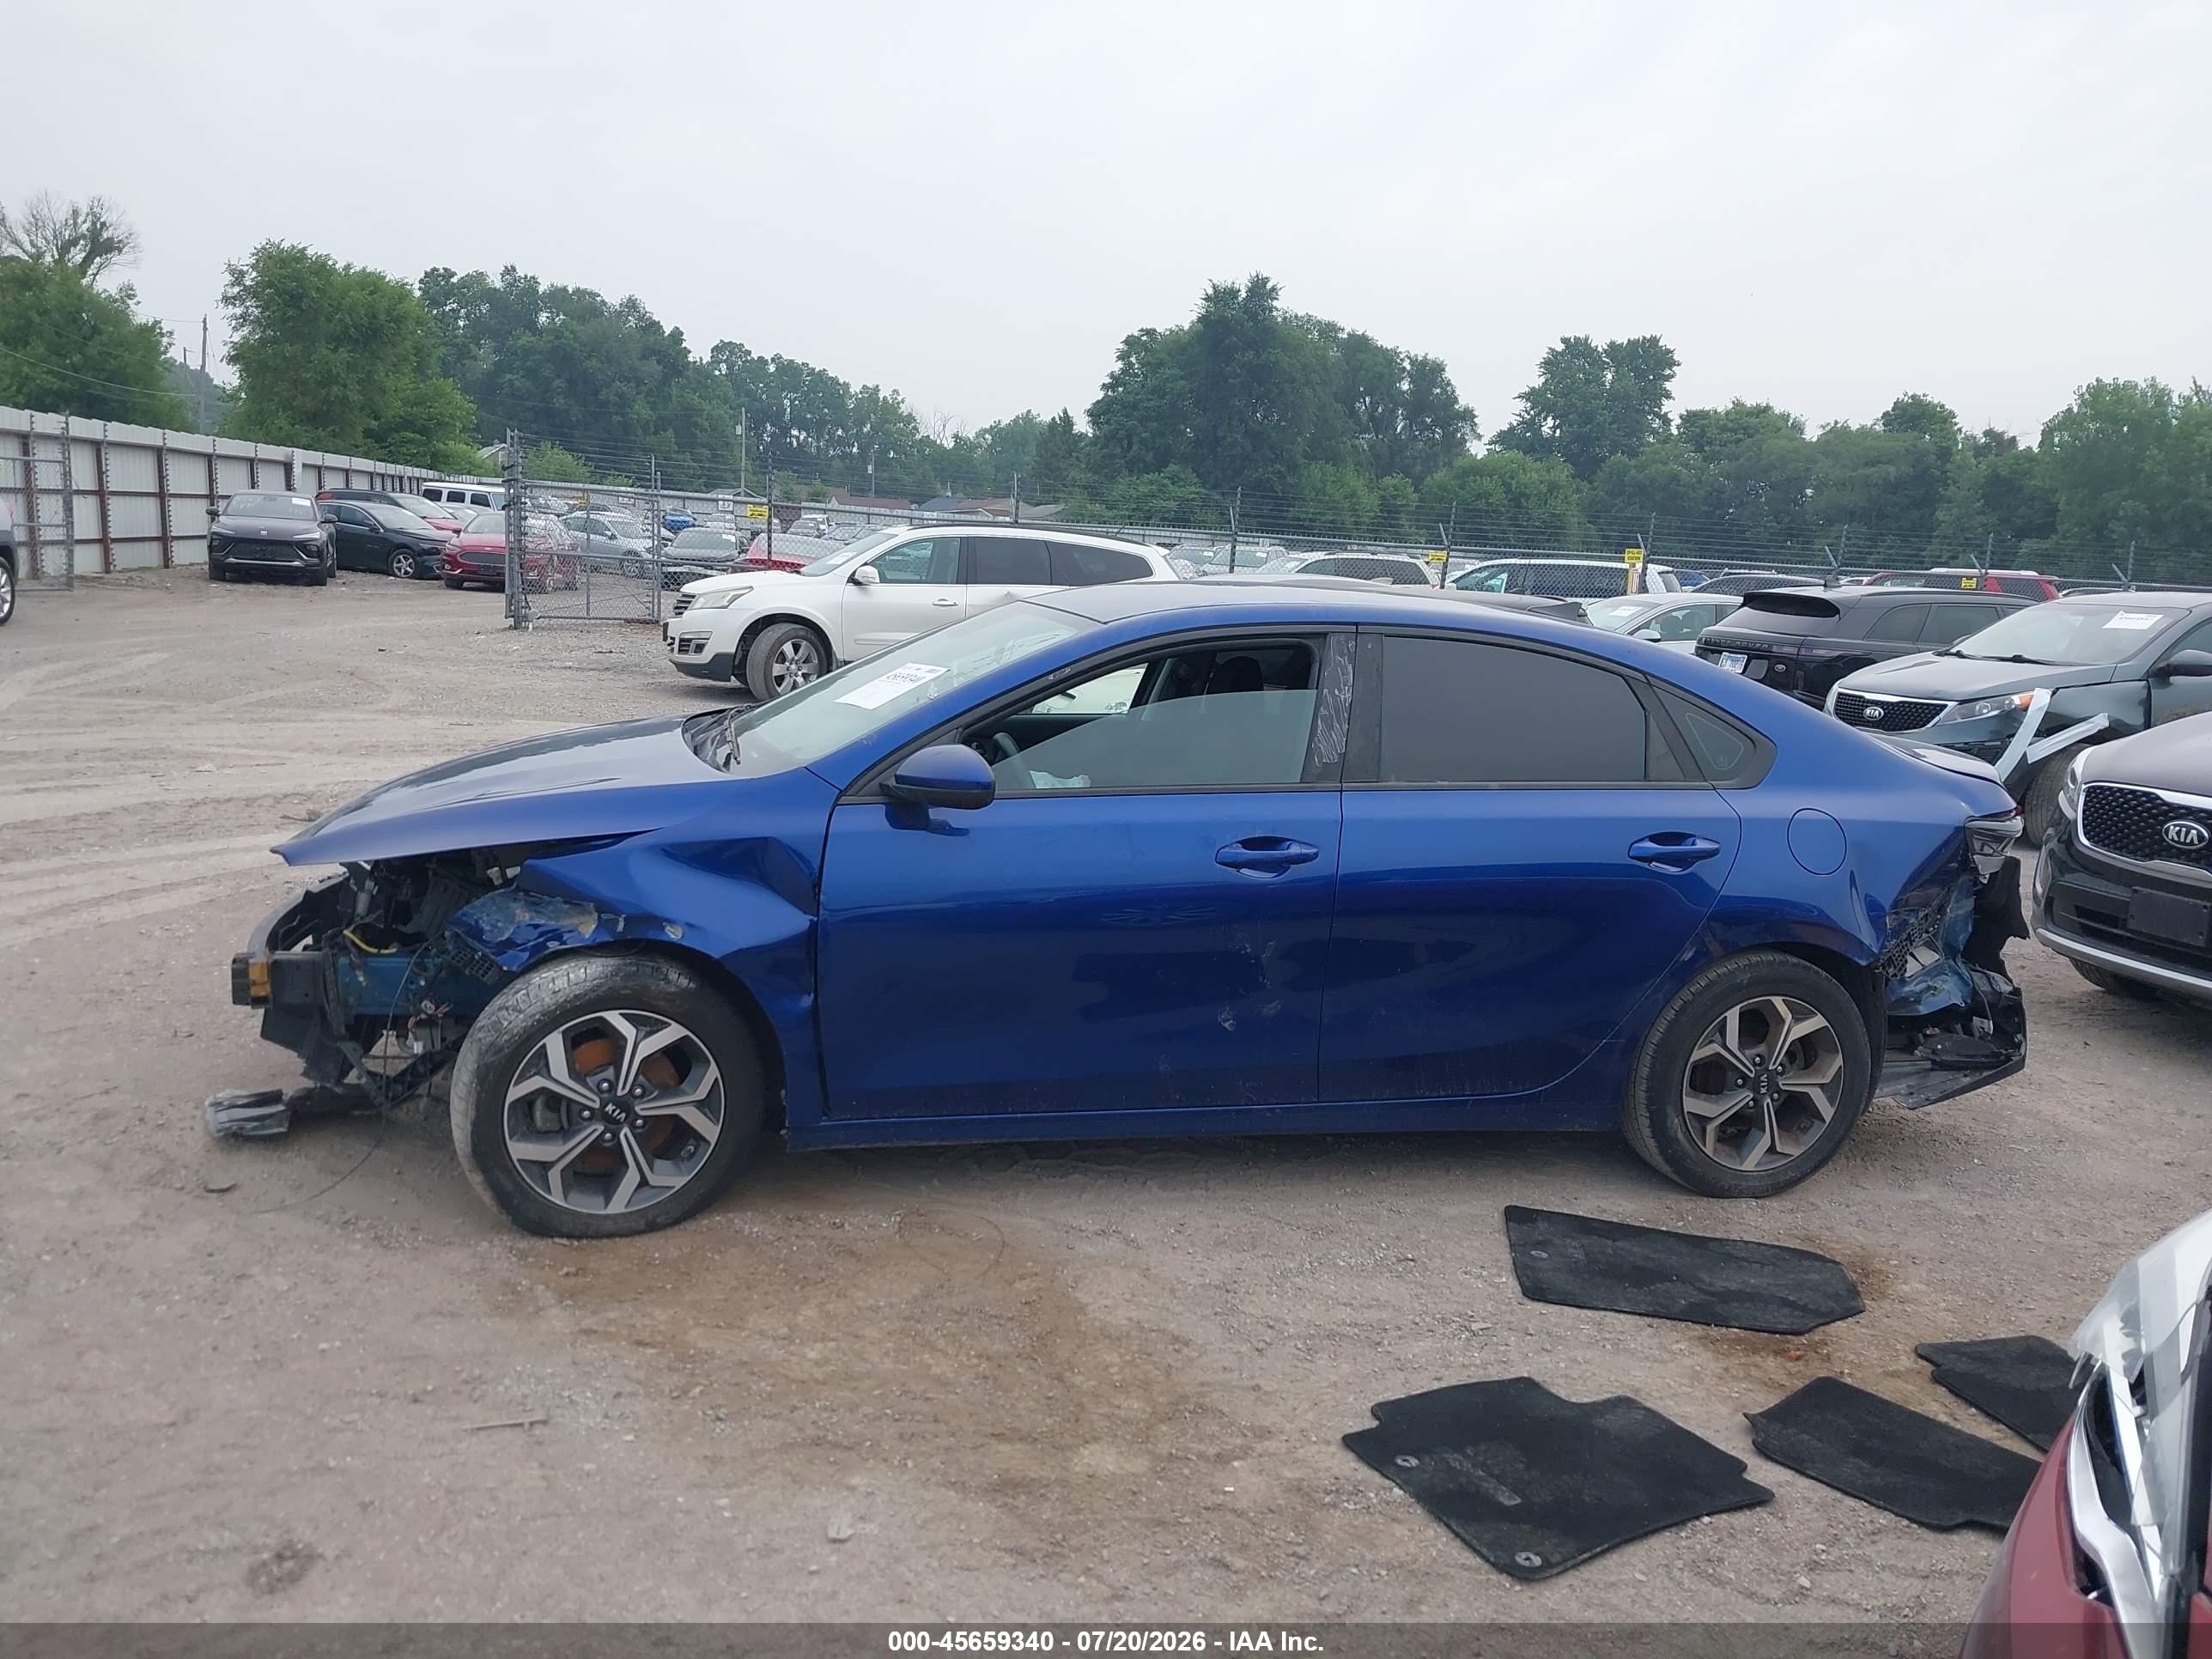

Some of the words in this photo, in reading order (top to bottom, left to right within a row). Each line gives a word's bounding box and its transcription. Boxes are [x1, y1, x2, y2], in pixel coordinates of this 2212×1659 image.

[1865, 708, 1880, 718] KIA
[2167, 824, 2199, 845] KIA
[605, 1102, 627, 1122] KIA
